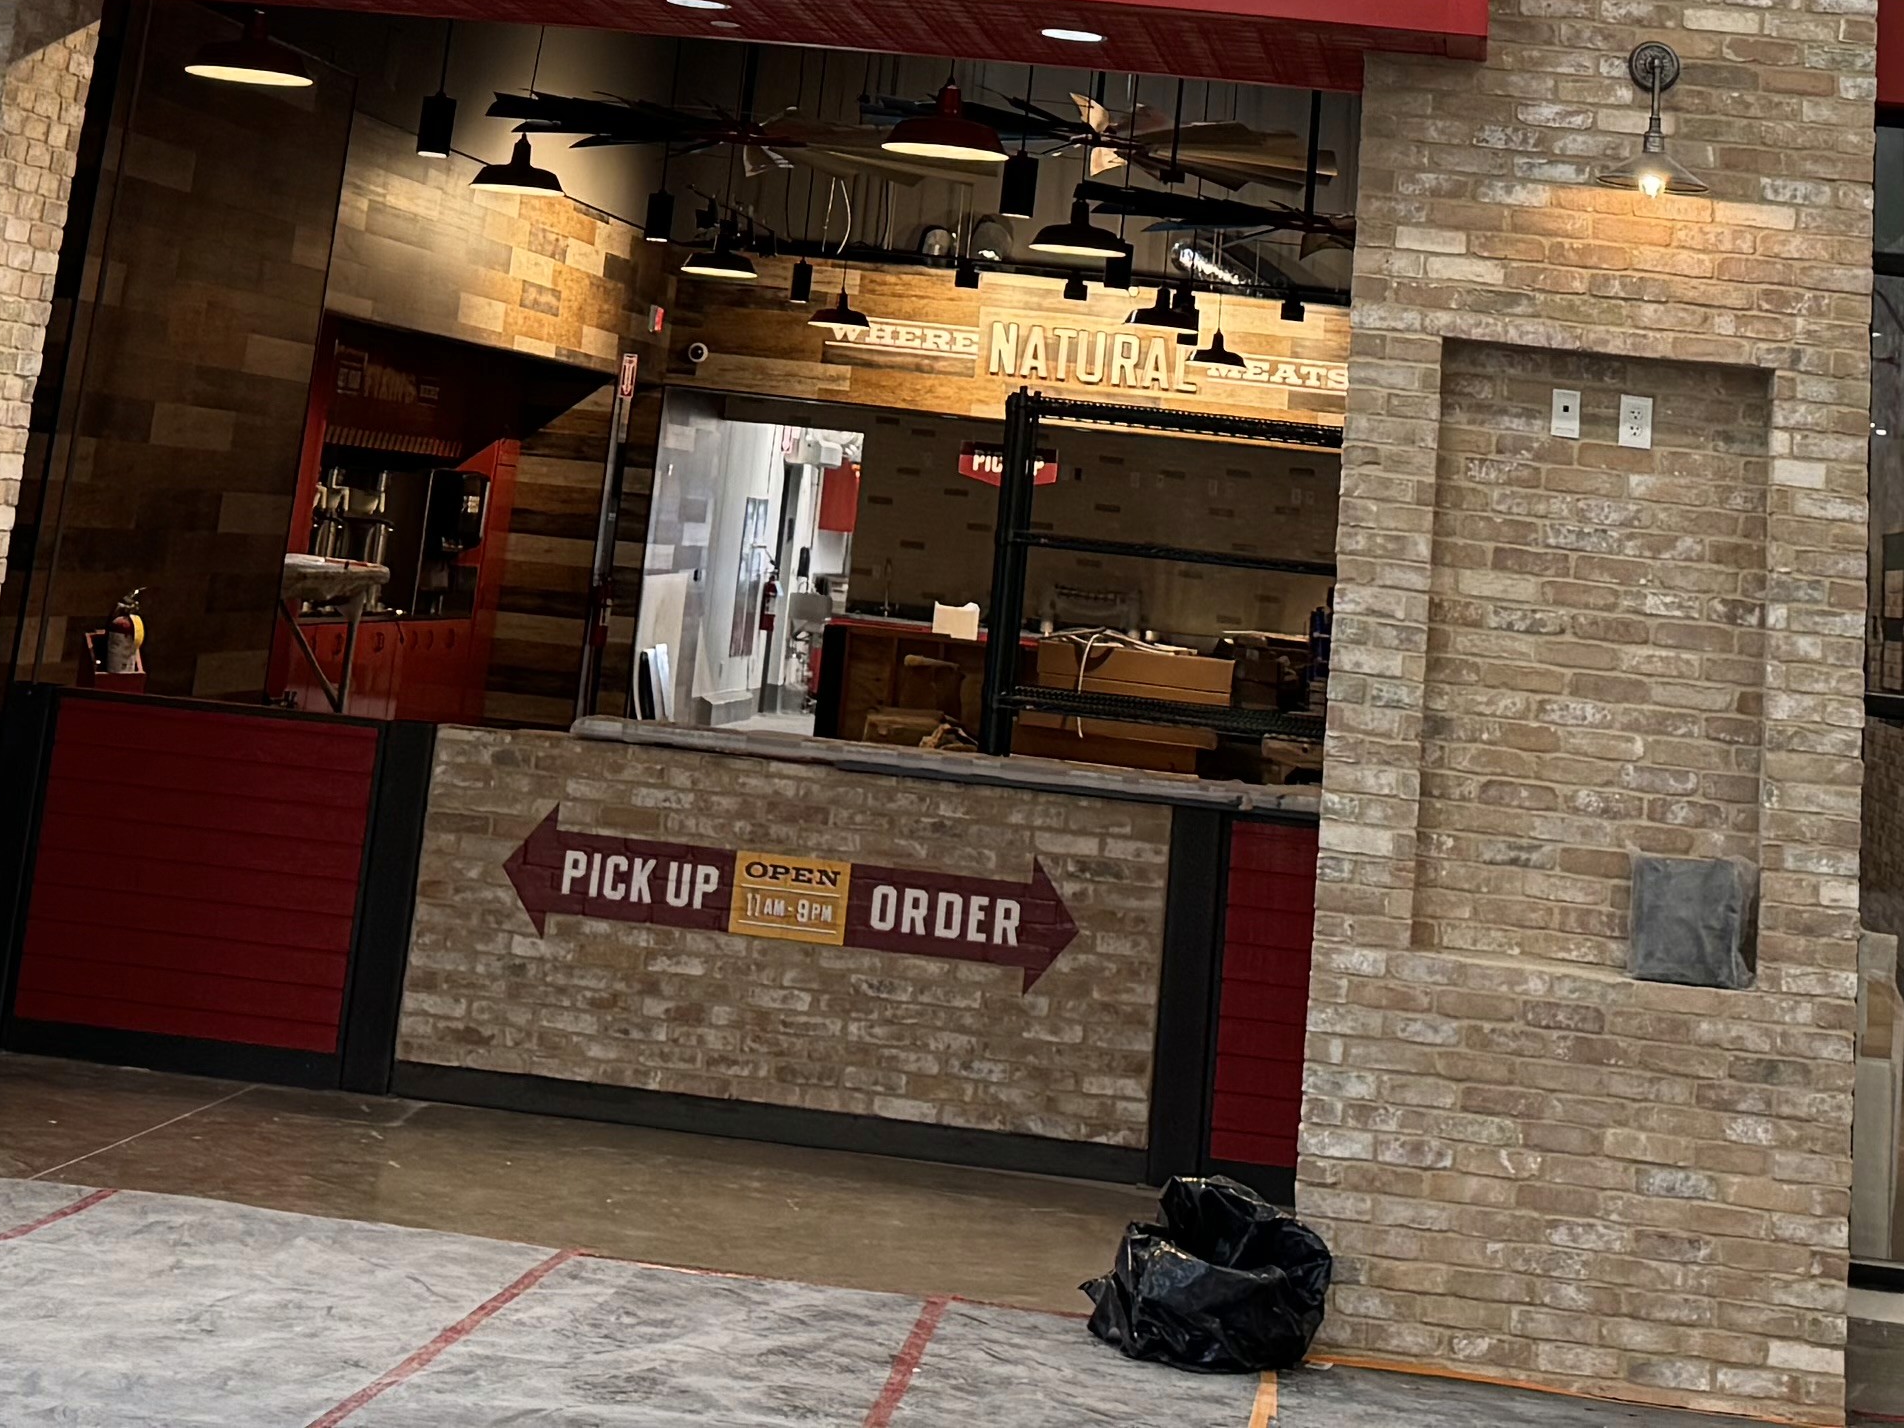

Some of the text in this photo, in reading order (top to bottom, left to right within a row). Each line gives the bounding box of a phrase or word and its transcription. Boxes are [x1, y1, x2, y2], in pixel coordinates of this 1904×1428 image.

[561, 850, 720, 910] PICK UP
[745, 860, 841, 888] OPEN
[870, 884, 1021, 947] ORDER
